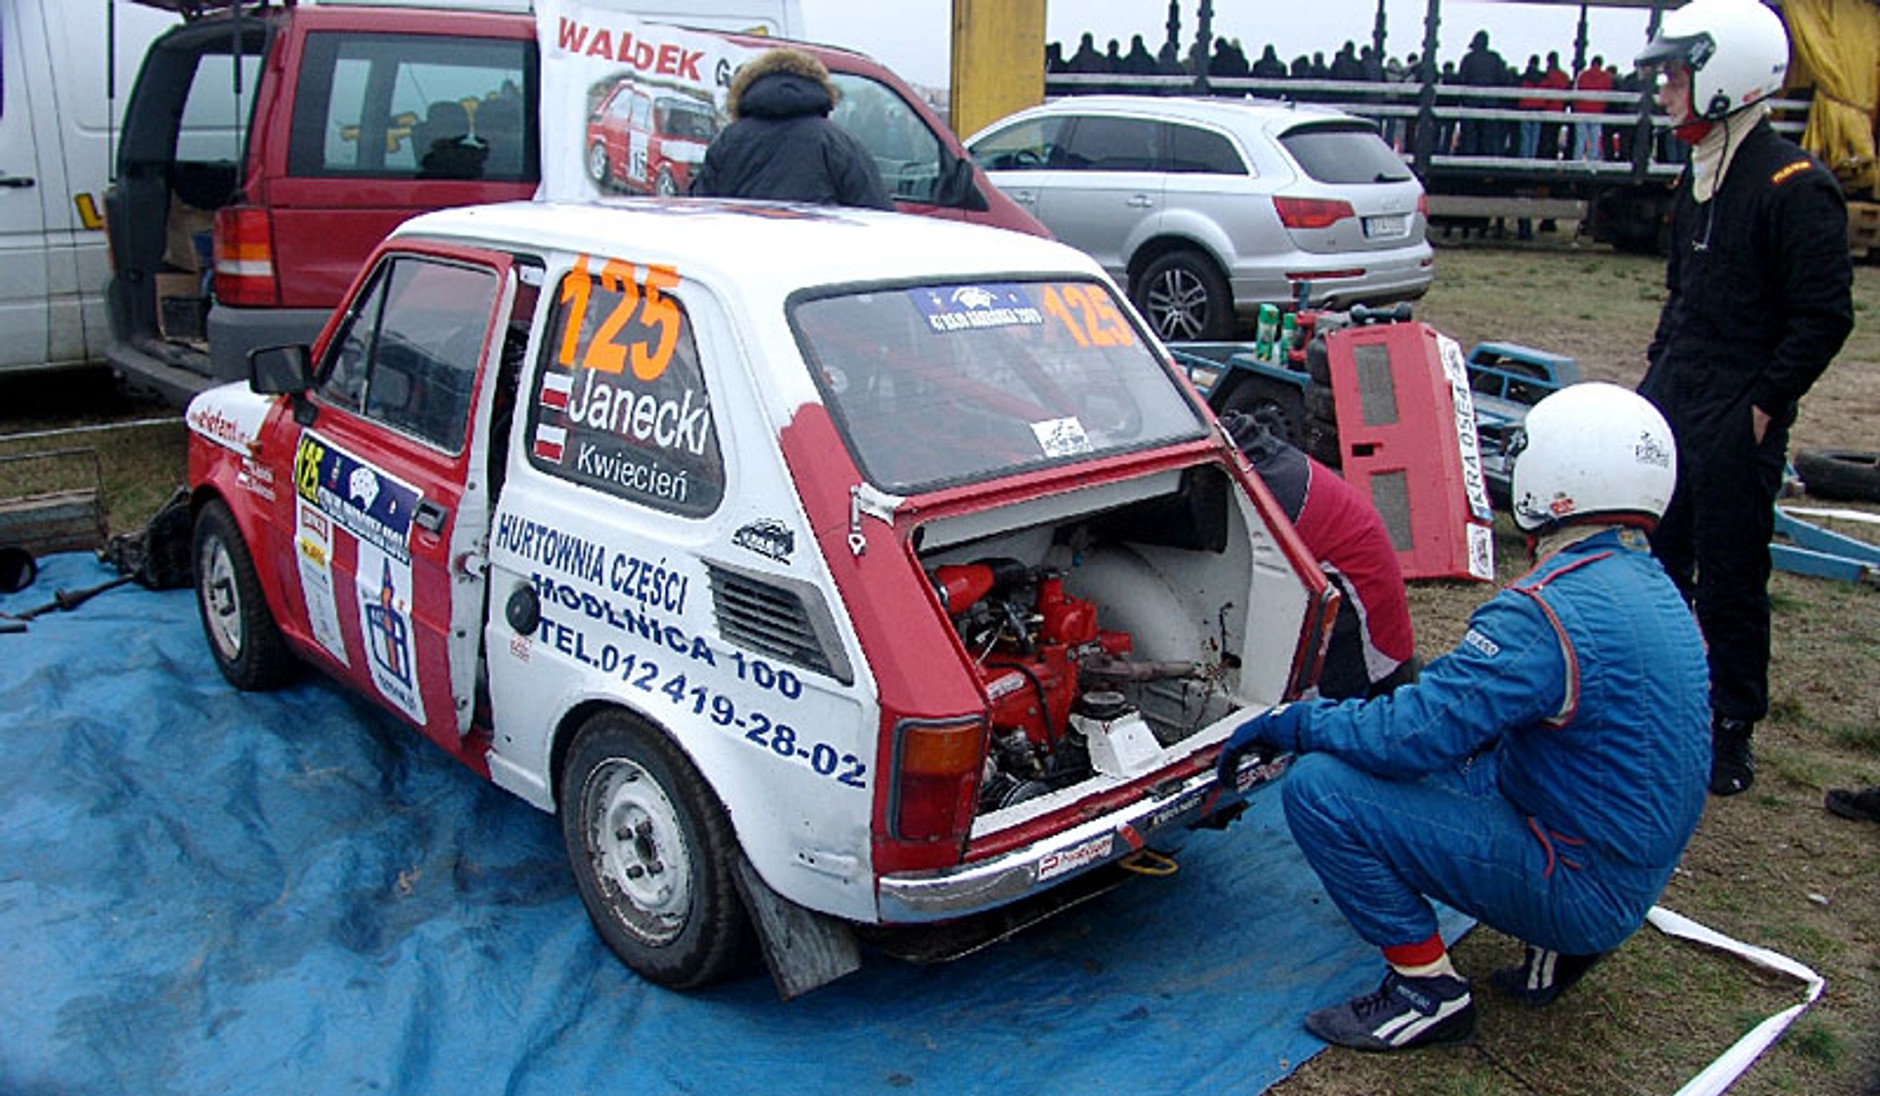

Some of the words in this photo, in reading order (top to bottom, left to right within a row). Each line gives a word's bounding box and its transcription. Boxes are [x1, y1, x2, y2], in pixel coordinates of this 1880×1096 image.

[559, 17, 706, 81] WALDEK
[559, 252, 682, 381] 125
[1043, 283, 1134, 347] 125
[568, 368, 709, 455] Janecki
[578, 442, 688, 502] Kwiecień
[496, 513, 605, 586] HURTOWNIA
[611, 557, 688, 615] CZĘŚCI
[532, 572, 716, 667] MODLNICA
[731, 652, 802, 700] 100
